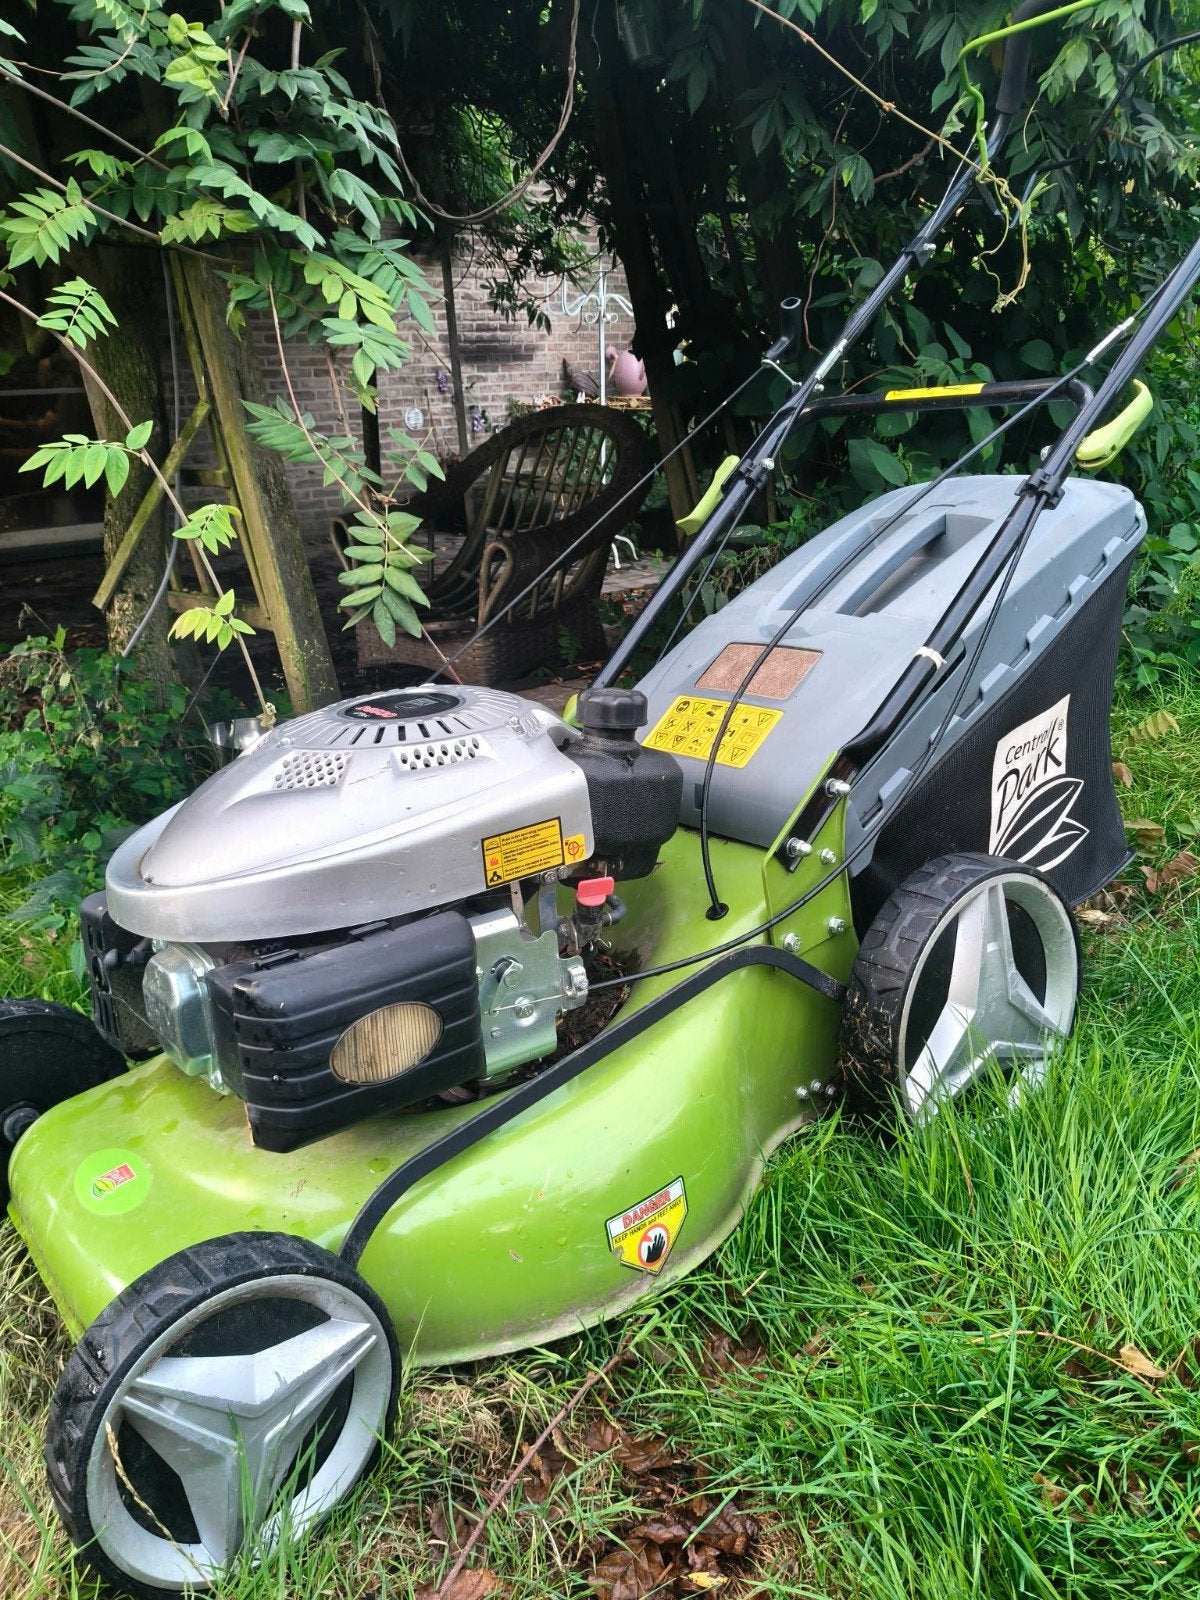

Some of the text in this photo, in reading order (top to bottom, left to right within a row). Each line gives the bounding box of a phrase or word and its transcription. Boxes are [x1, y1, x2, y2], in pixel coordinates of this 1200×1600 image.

[1005, 721, 1053, 765] Central
[996, 717, 1063, 834] Park
[614, 1199, 682, 1244] KEEP HANDS and FEET AWAY
[622, 1190, 671, 1229] DANGER
